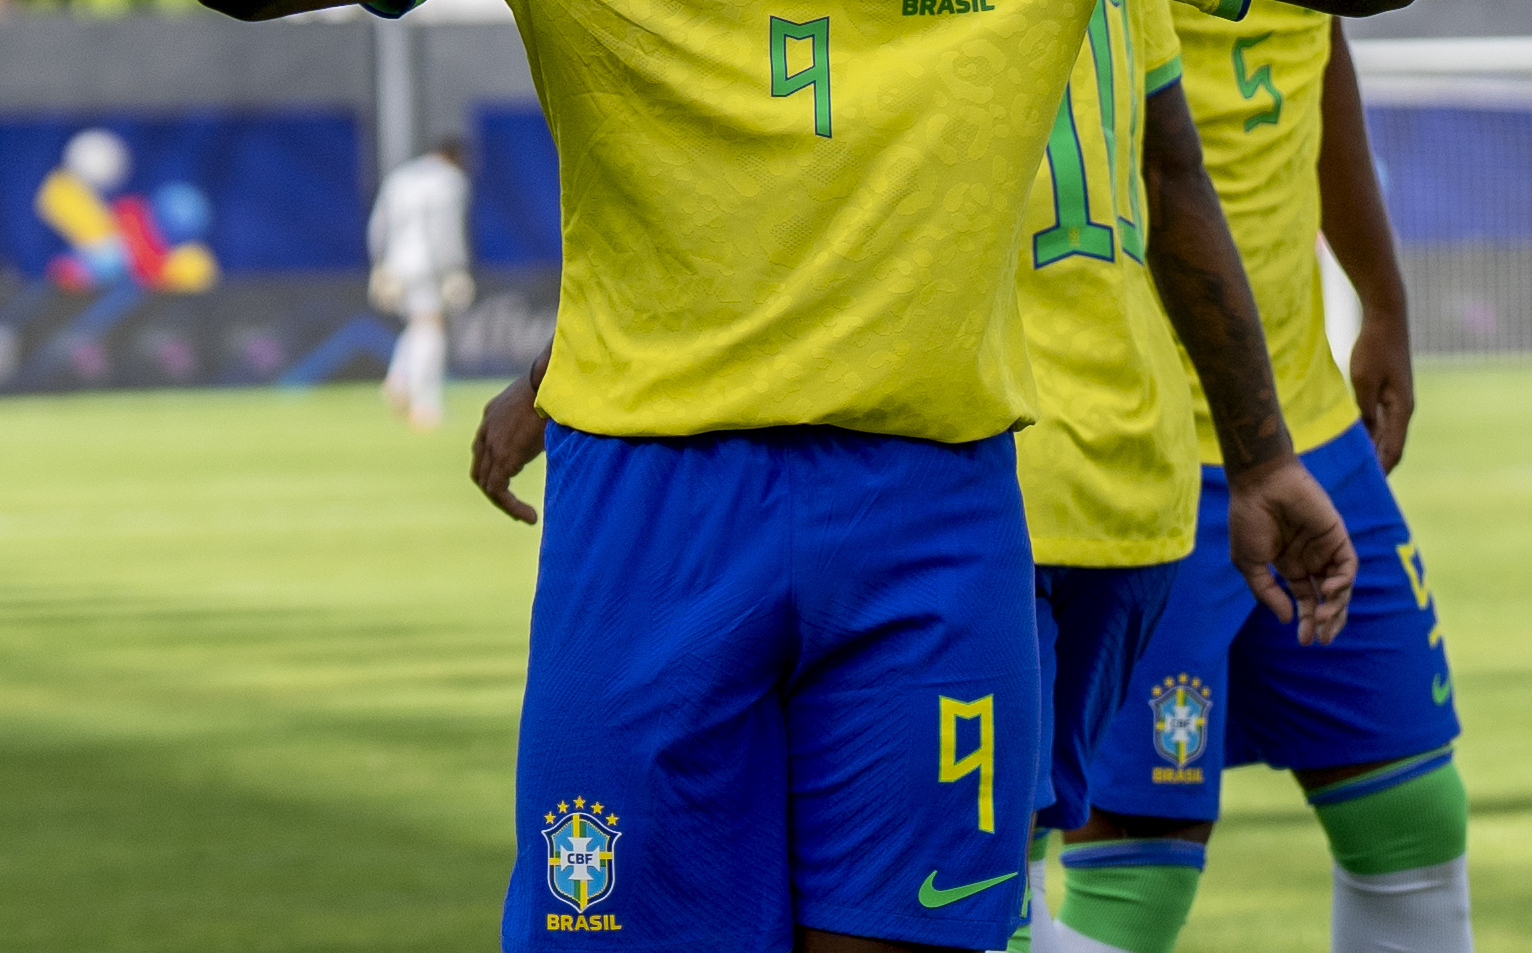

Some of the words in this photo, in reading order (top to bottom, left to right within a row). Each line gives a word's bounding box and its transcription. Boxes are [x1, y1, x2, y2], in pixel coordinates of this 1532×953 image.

[769, 15, 833, 139] 9
[1231, 31, 1283, 133] 5
[938, 693, 996, 835] 9
[1153, 768, 1203, 783] BRASIL
[567, 853, 593, 865] CBF
[546, 913, 622, 931] BRASIL
